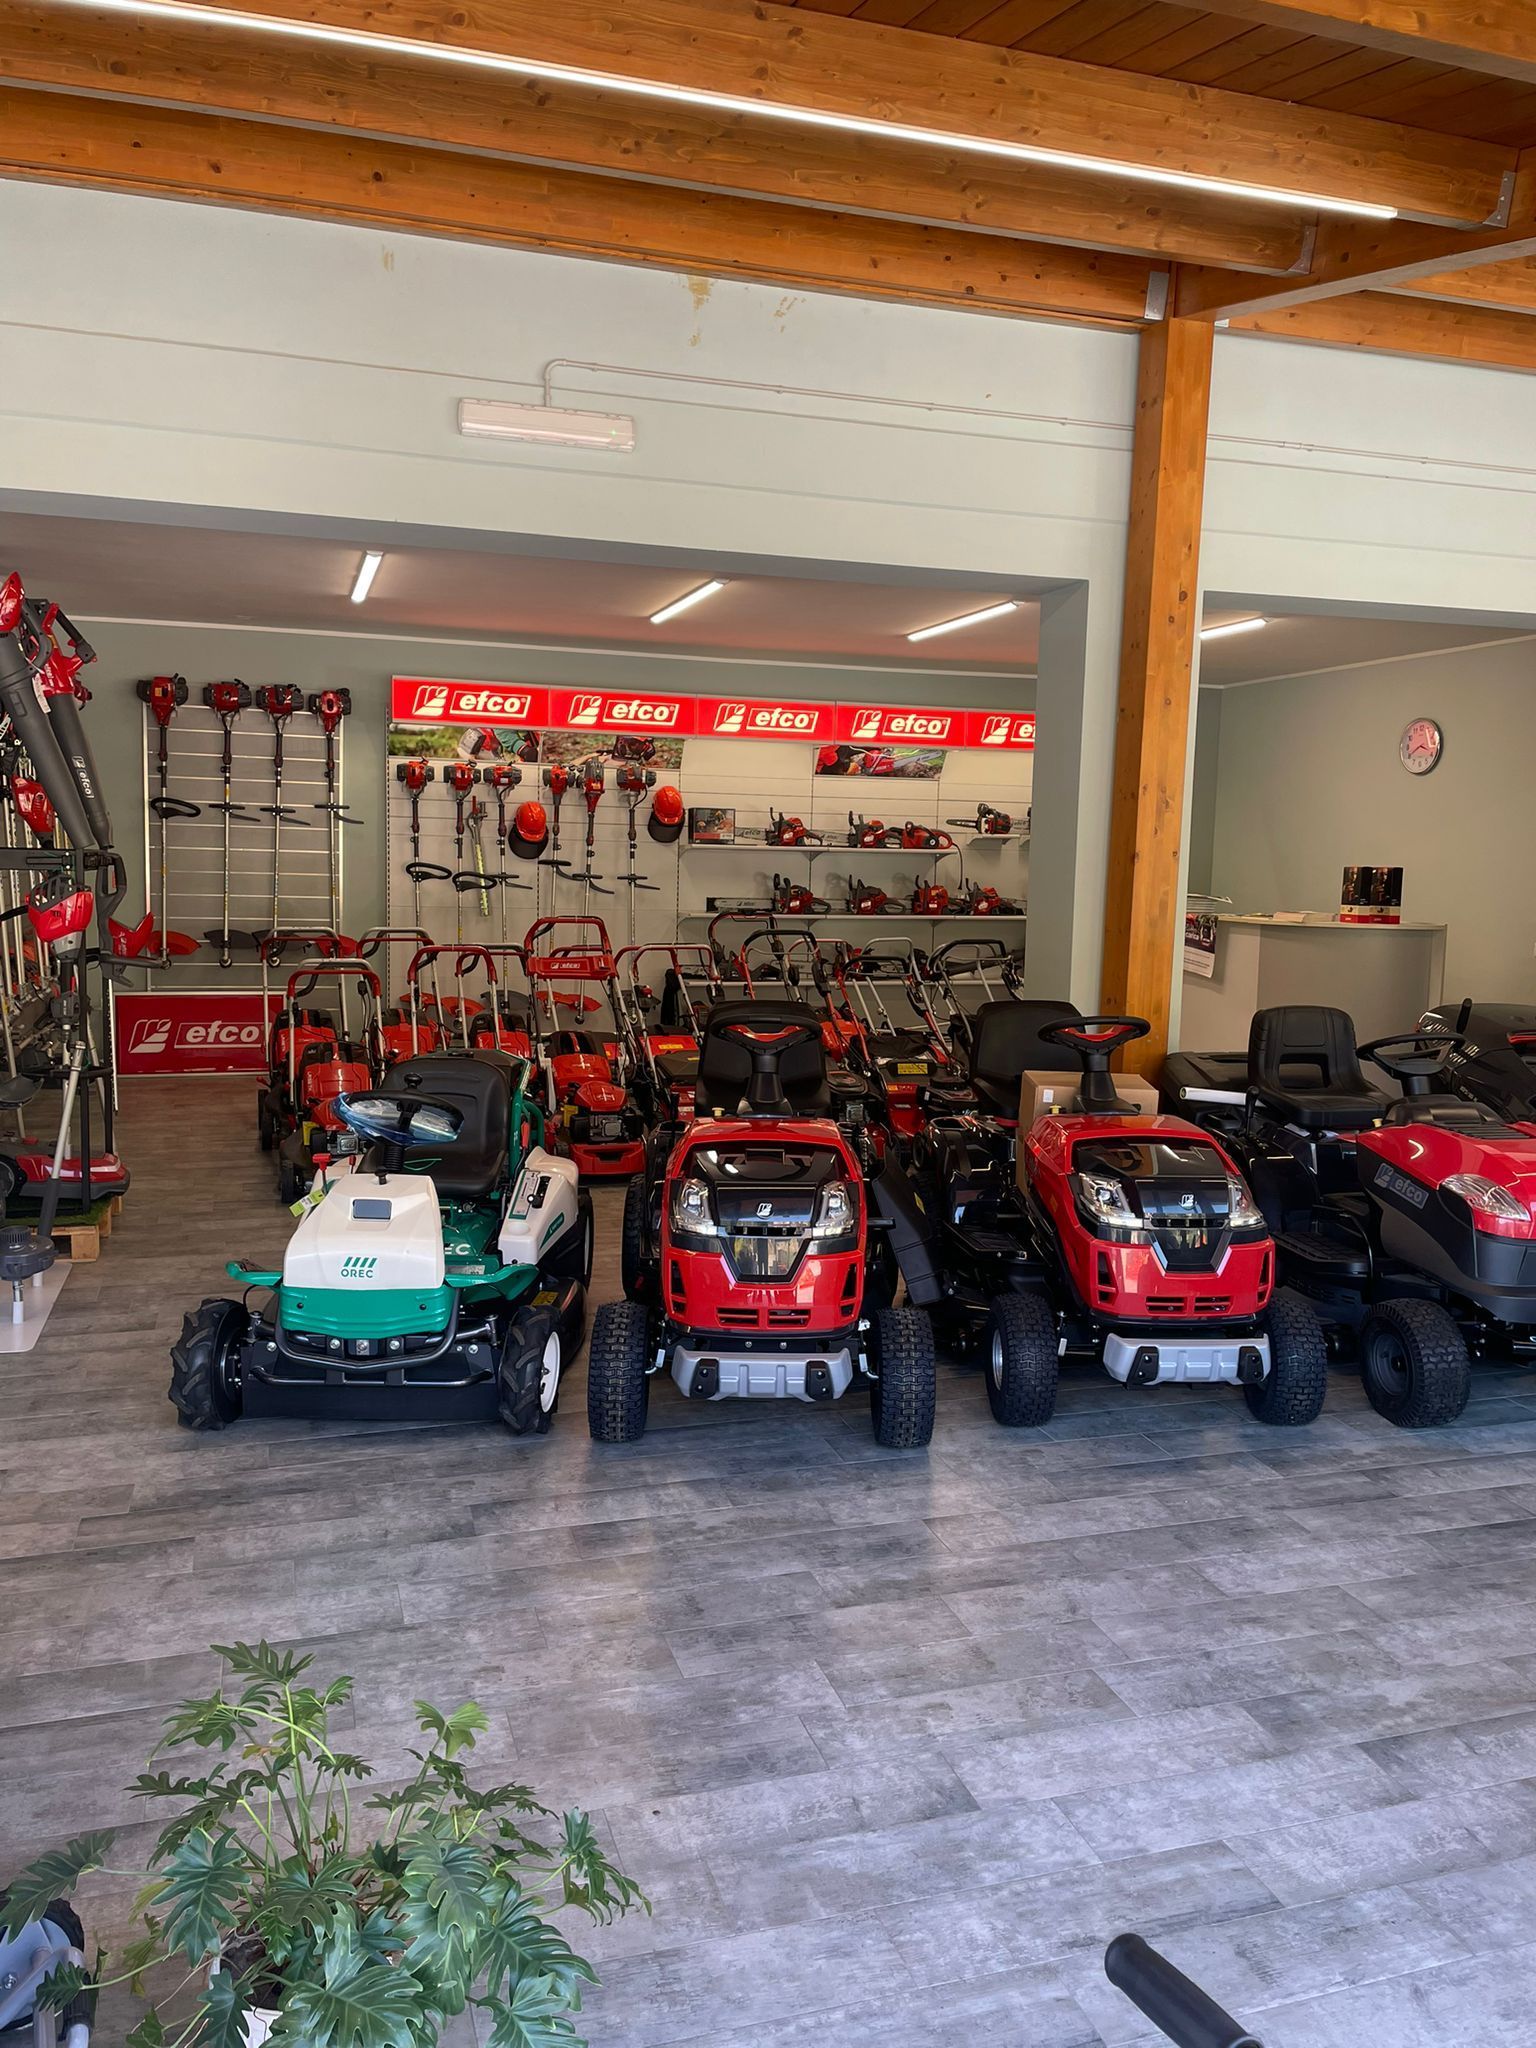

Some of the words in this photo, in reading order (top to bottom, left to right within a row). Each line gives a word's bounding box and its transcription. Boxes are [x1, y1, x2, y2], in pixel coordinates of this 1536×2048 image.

[459, 690, 521, 713] efco
[611, 700, 670, 721] efco
[755, 708, 810, 728] efco
[890, 713, 942, 734] efco
[79, 771, 91, 795] efco
[185, 1020, 260, 1043] efco
[1395, 1179, 1423, 1202] efco
[340, 1268, 374, 1279] OREC
